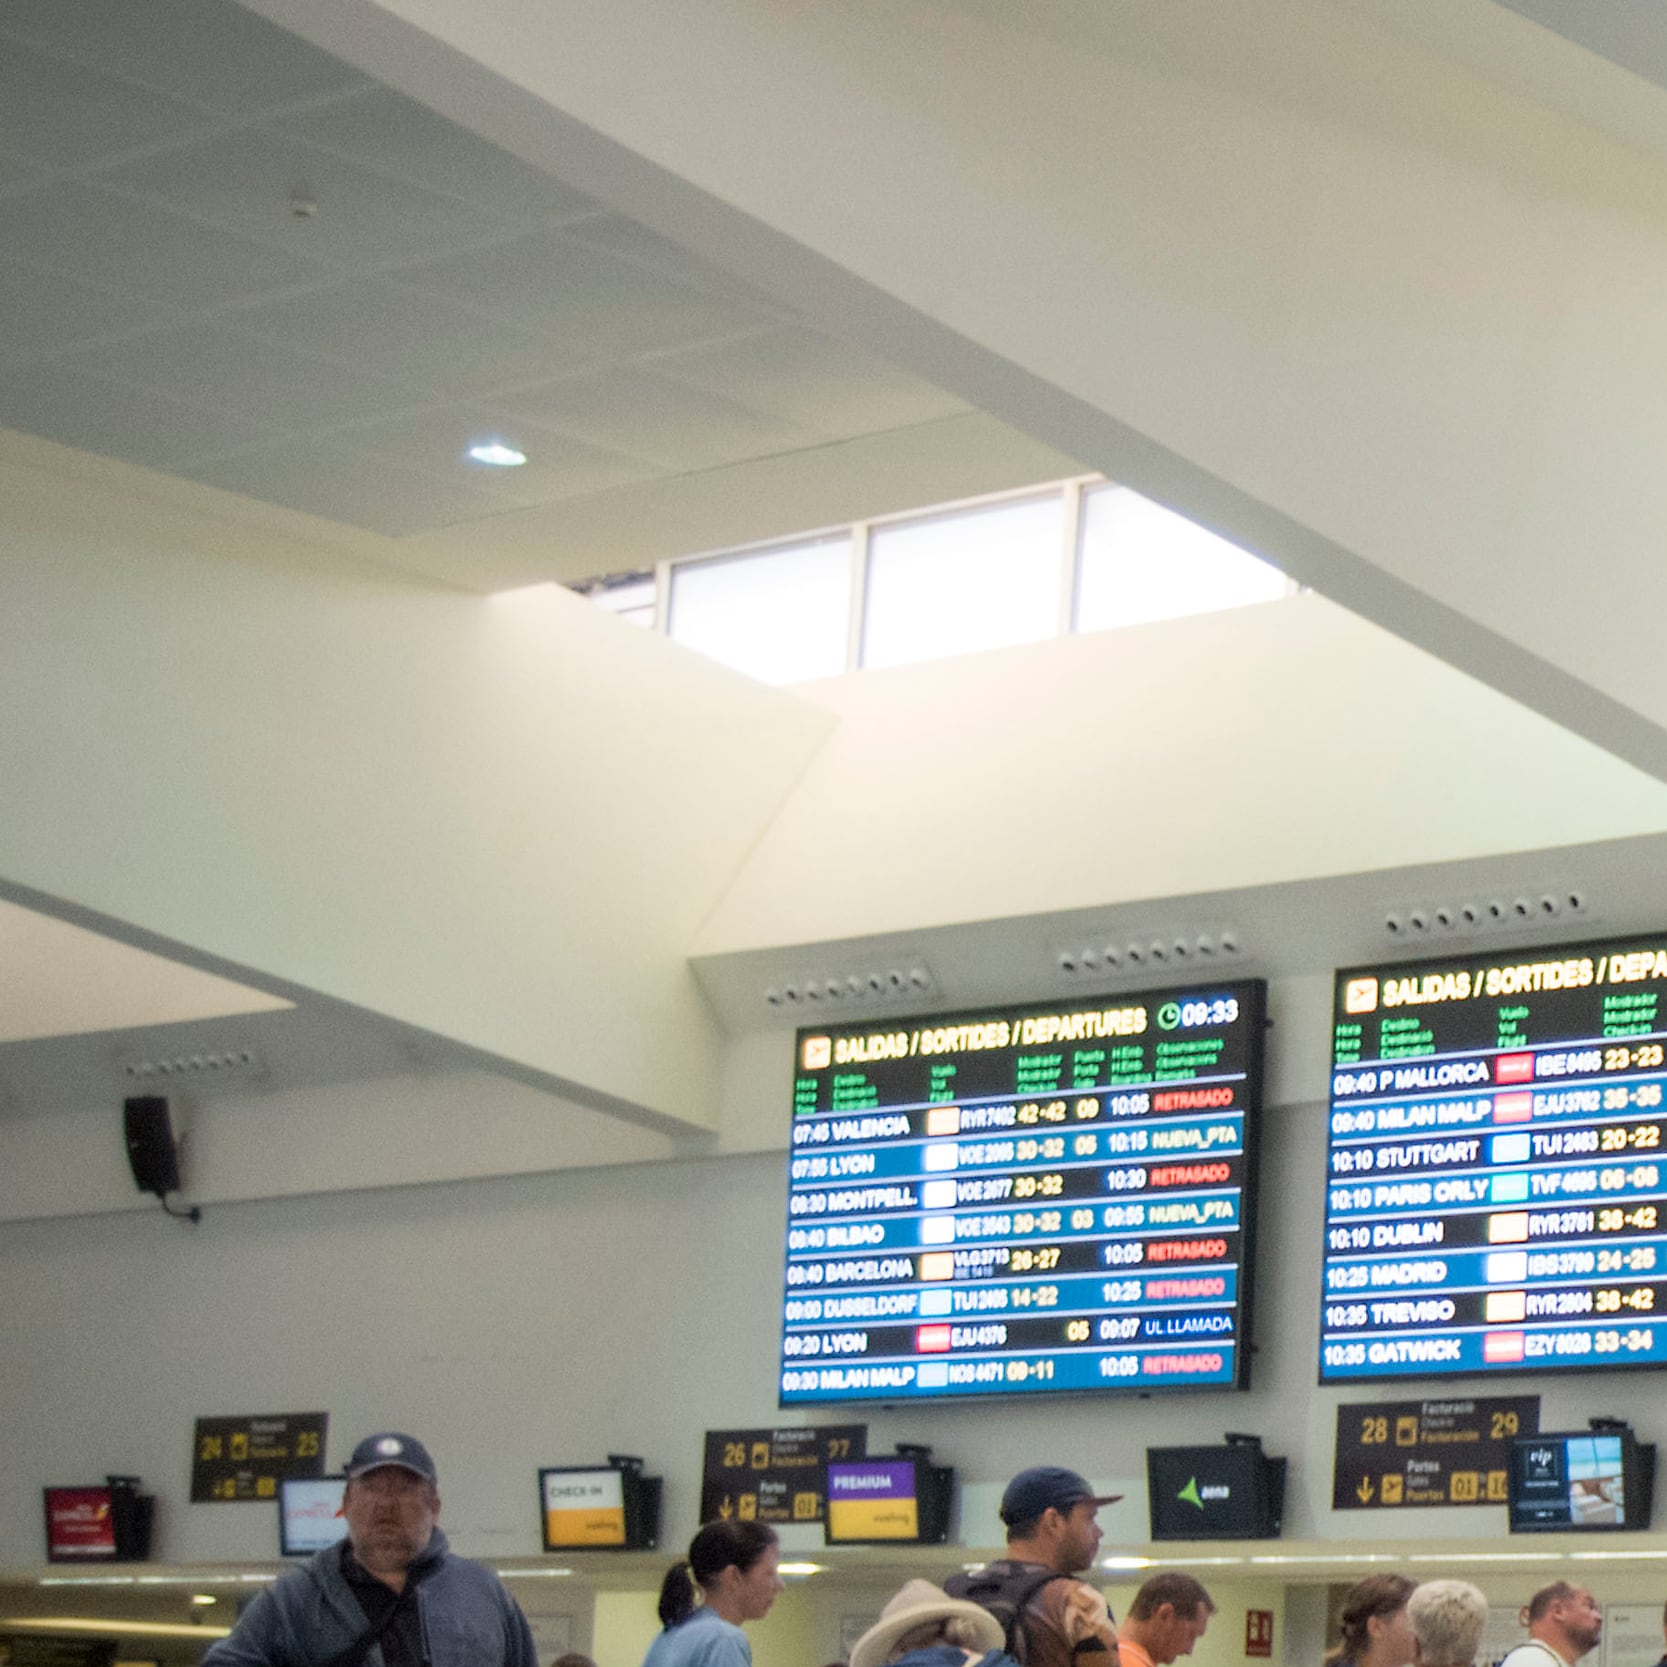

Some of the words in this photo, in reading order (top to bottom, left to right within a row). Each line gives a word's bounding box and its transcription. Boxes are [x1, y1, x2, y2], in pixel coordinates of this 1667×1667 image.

[1381, 970, 1472, 1009] SALIDAS
[1484, 956, 1595, 998] SORTIDES
[833, 1031, 910, 1065] SALIDAS
[918, 1020, 1011, 1057] SORTIDES
[1021, 1005, 1148, 1046] DEPARTURES
[830, 1114, 911, 1142] VALENCIA
[1151, 1086, 1235, 1113] RETRASADO
[1375, 1139, 1481, 1170] STUTTGART
[1372, 1181, 1433, 1208] PARIS
[1372, 1220, 1445, 1248] DUBLIN
[1166, 1315, 1234, 1335] LLAMADA
[1361, 1417, 1387, 1444] 28
[1490, 1412, 1518, 1439] 29
[723, 1443, 745, 1467] 26
[834, 1476, 892, 1489] PREMIUM
